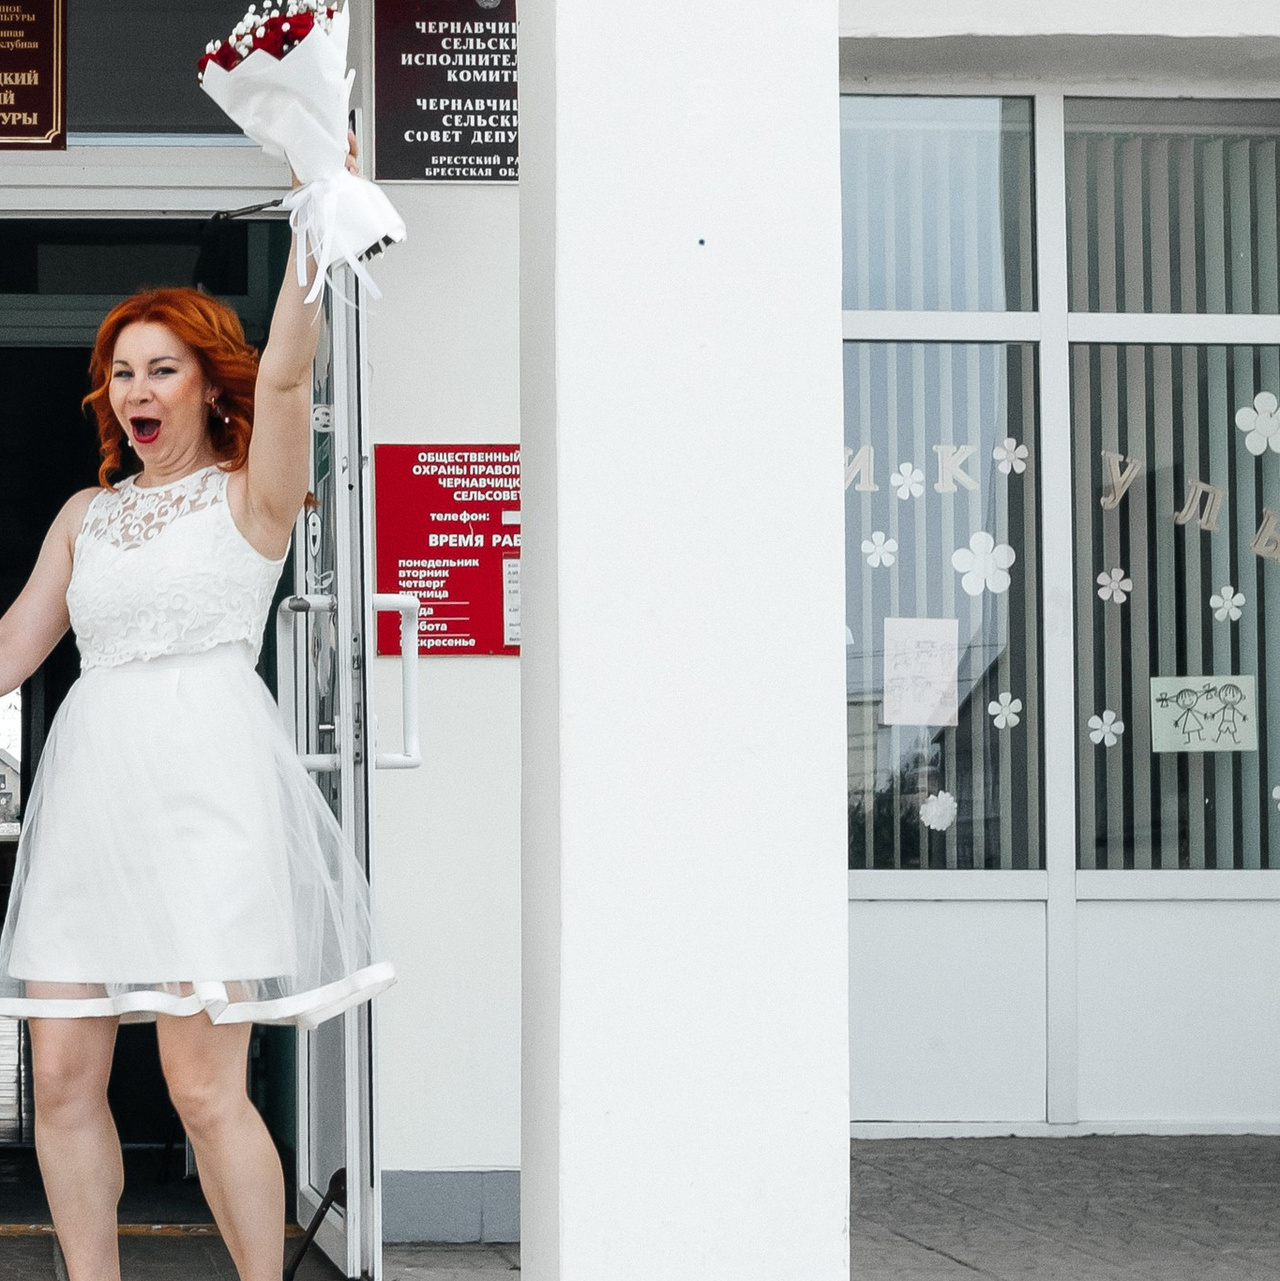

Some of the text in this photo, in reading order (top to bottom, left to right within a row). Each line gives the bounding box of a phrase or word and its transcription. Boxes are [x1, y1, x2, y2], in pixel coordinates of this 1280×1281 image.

[404, 131, 462, 142] СОВЕТ
[432, 155, 500, 165] БРЕСТСКИЙ
[425, 168, 492, 176] БРЕСТСКАЯ
[412, 465, 467, 475] ОХРАНЫ
[430, 510, 490, 524] телефон:
[429, 534, 484, 547] ВРЕМЯ
[398, 558, 479, 569] понедельник
[398, 570, 449, 579] вторник
[399, 580, 446, 589] четверг
